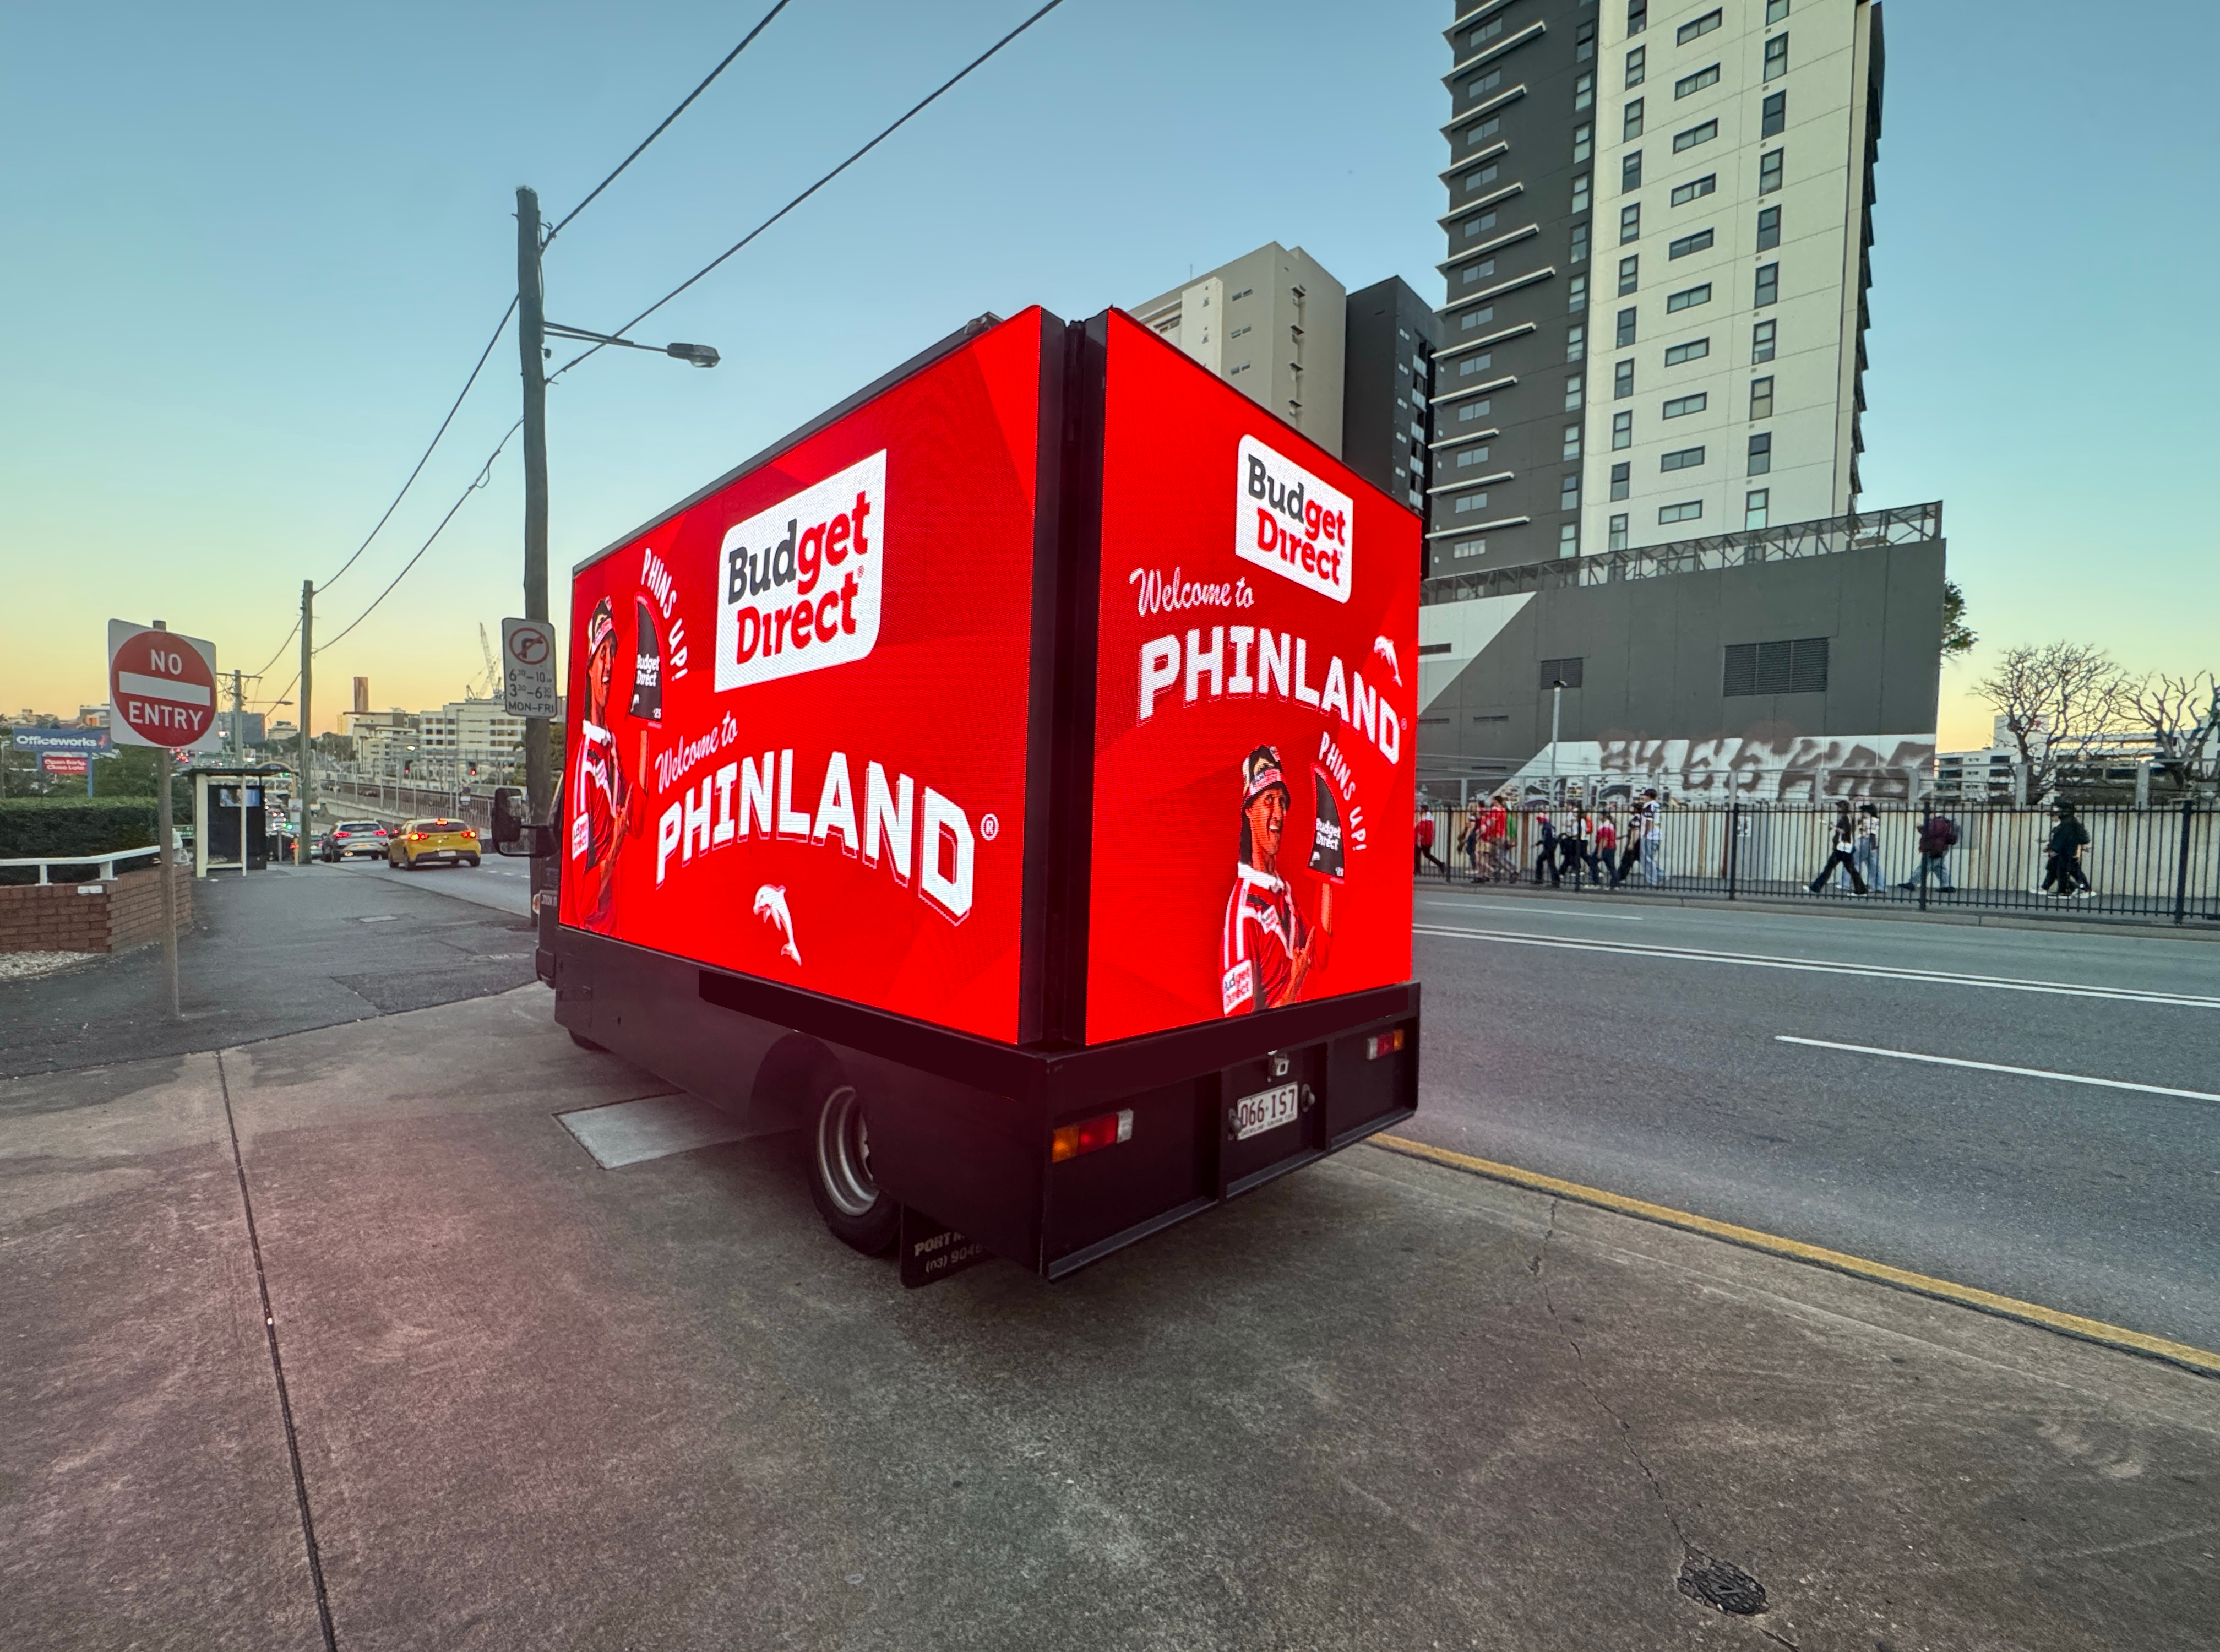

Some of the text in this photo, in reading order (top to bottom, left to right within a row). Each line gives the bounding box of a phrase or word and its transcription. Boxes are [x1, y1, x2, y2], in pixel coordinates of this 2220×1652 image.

[1248, 453, 1345, 547] Budget
[728, 491, 870, 605] Budget
[1256, 506, 1340, 587] Direct
[641, 548, 688, 681] PHINS UP!
[737, 571, 859, 665] Direct
[1129, 566, 1255, 617] Welcome to
[151, 649, 183, 675] NO
[1138, 625, 1401, 767] PHINLAND
[16, 735, 97, 747] Officeworks
[129, 701, 203, 731] ENTRY
[654, 710, 738, 795] Welcome to
[655, 747, 975, 921] PHINLAND
[1318, 731, 1367, 851] PHINS UP!
[913, 1231, 951, 1257] PORT
